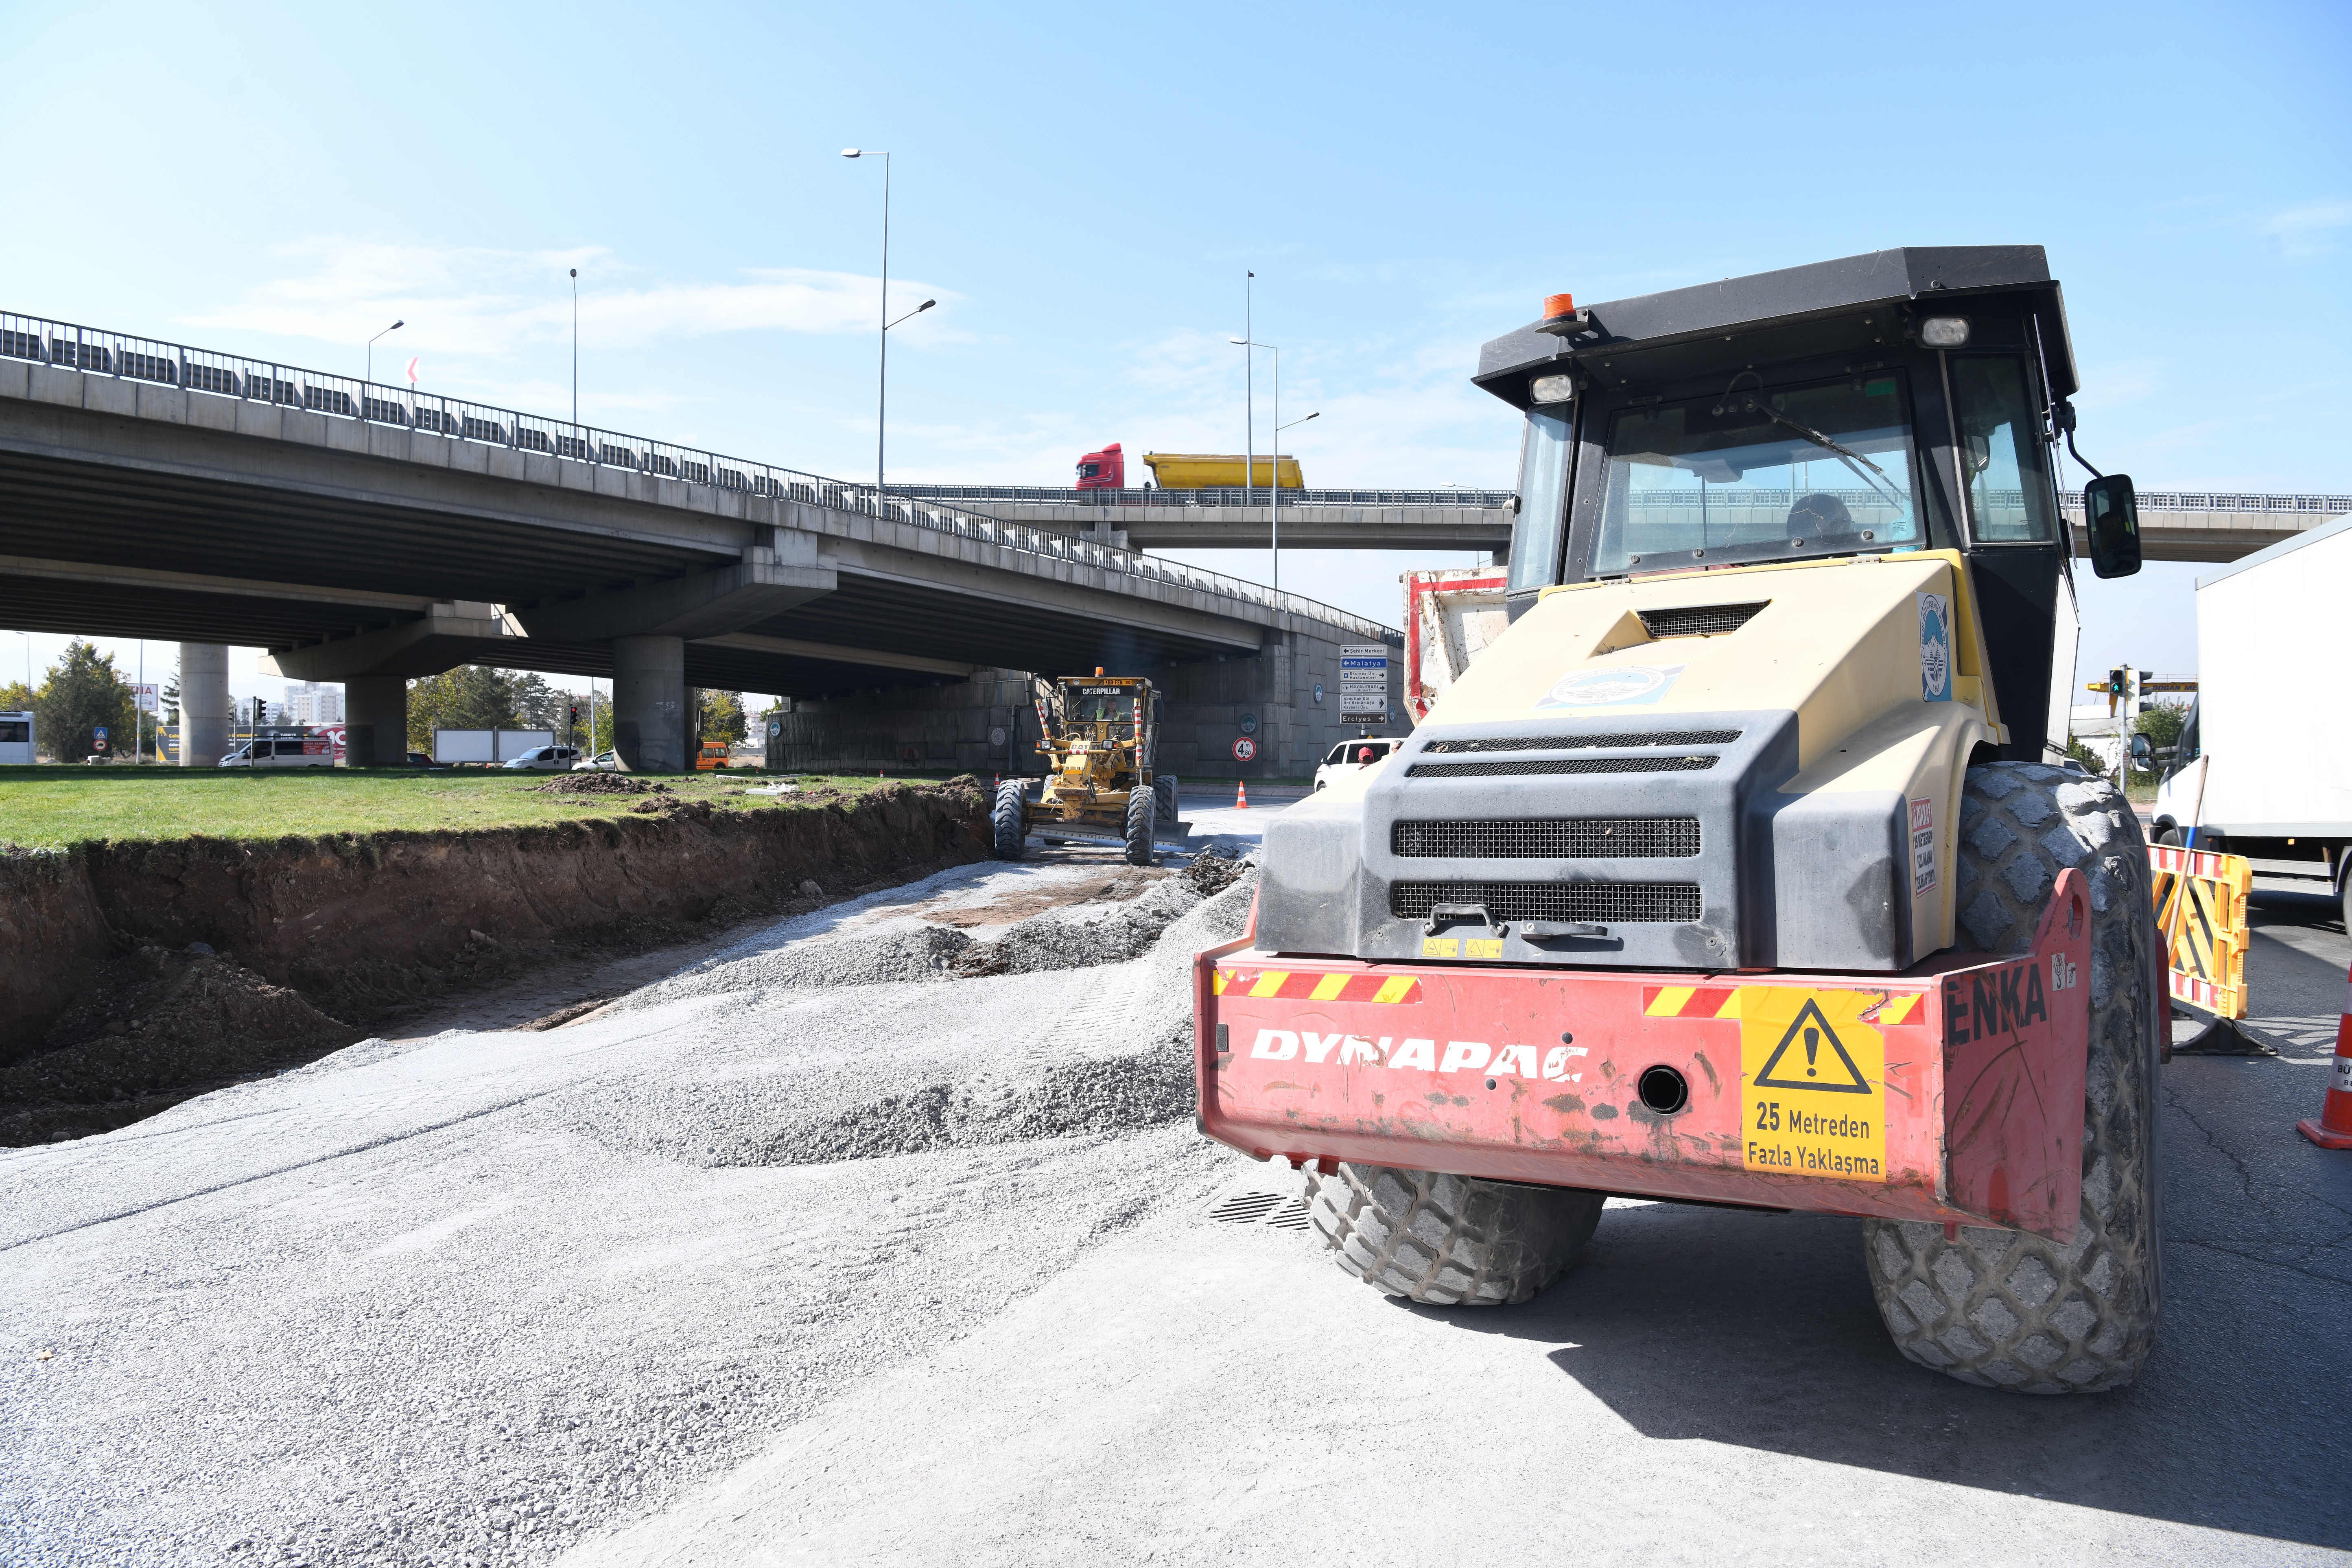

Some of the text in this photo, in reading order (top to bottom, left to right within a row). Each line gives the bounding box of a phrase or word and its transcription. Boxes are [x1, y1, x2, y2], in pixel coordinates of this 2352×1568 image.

[1916, 803, 1931, 827] DİKKAT
[1914, 830, 1932, 849] 25 METREDEN
[1946, 962, 2047, 1049] ENKA
[1250, 1028, 1589, 1083] DYNAPAC
[2337, 1064, 2352, 1074] BÜ
[1756, 1101, 1869, 1139] 25 Metreden
[1748, 1141, 1879, 1176] Fazla Yaklaşma
